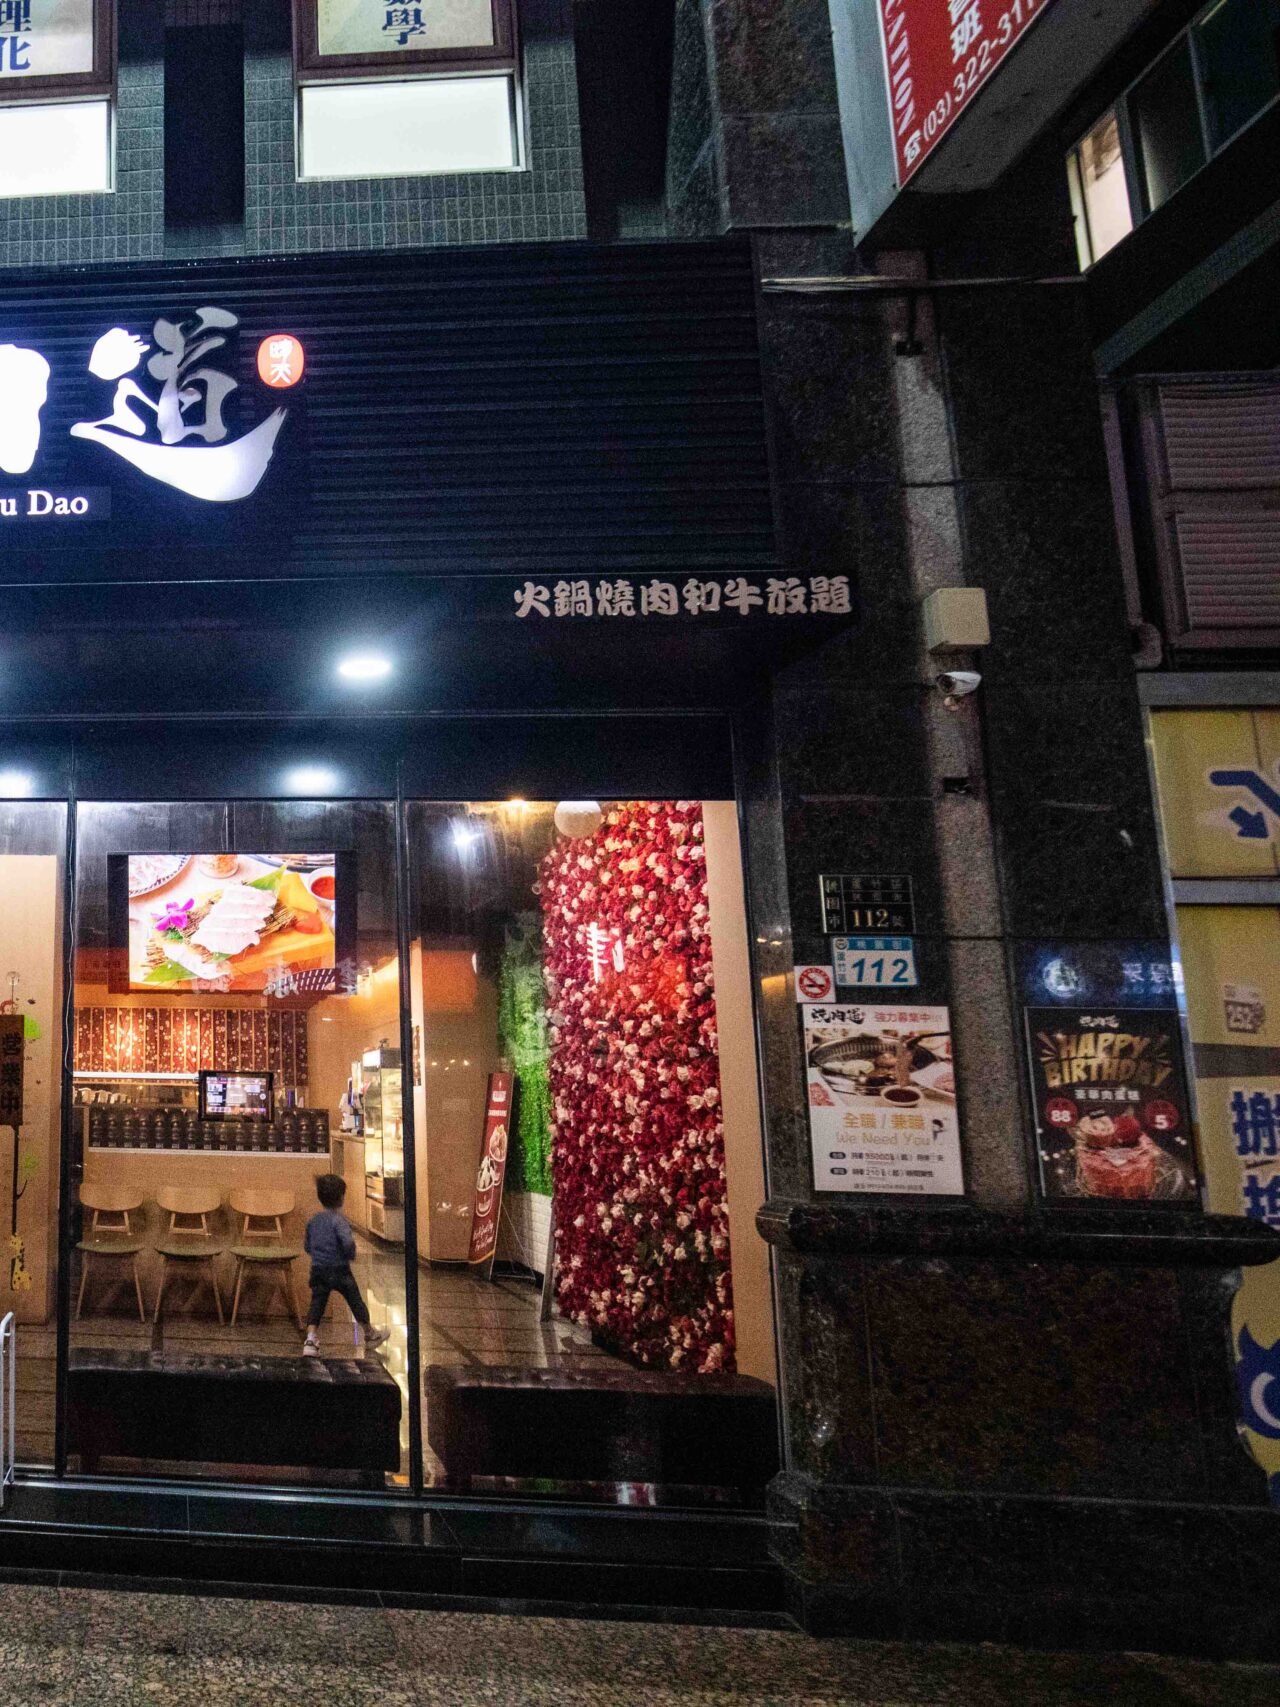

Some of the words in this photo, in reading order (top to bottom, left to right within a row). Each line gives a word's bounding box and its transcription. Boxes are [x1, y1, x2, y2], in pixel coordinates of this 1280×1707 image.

[381, 0, 427, 45] 學
[923, 91, 952, 142] (03)
[27, 492, 89, 518] Dao
[513, 575, 854, 619] 火鍋燒肉和牛放題
[851, 957, 909, 983] 112
[1056, 1032, 1151, 1060] HAPPY
[1043, 1056, 1173, 1089] BIRTHDAY
[862, 1132, 898, 1145] Need
